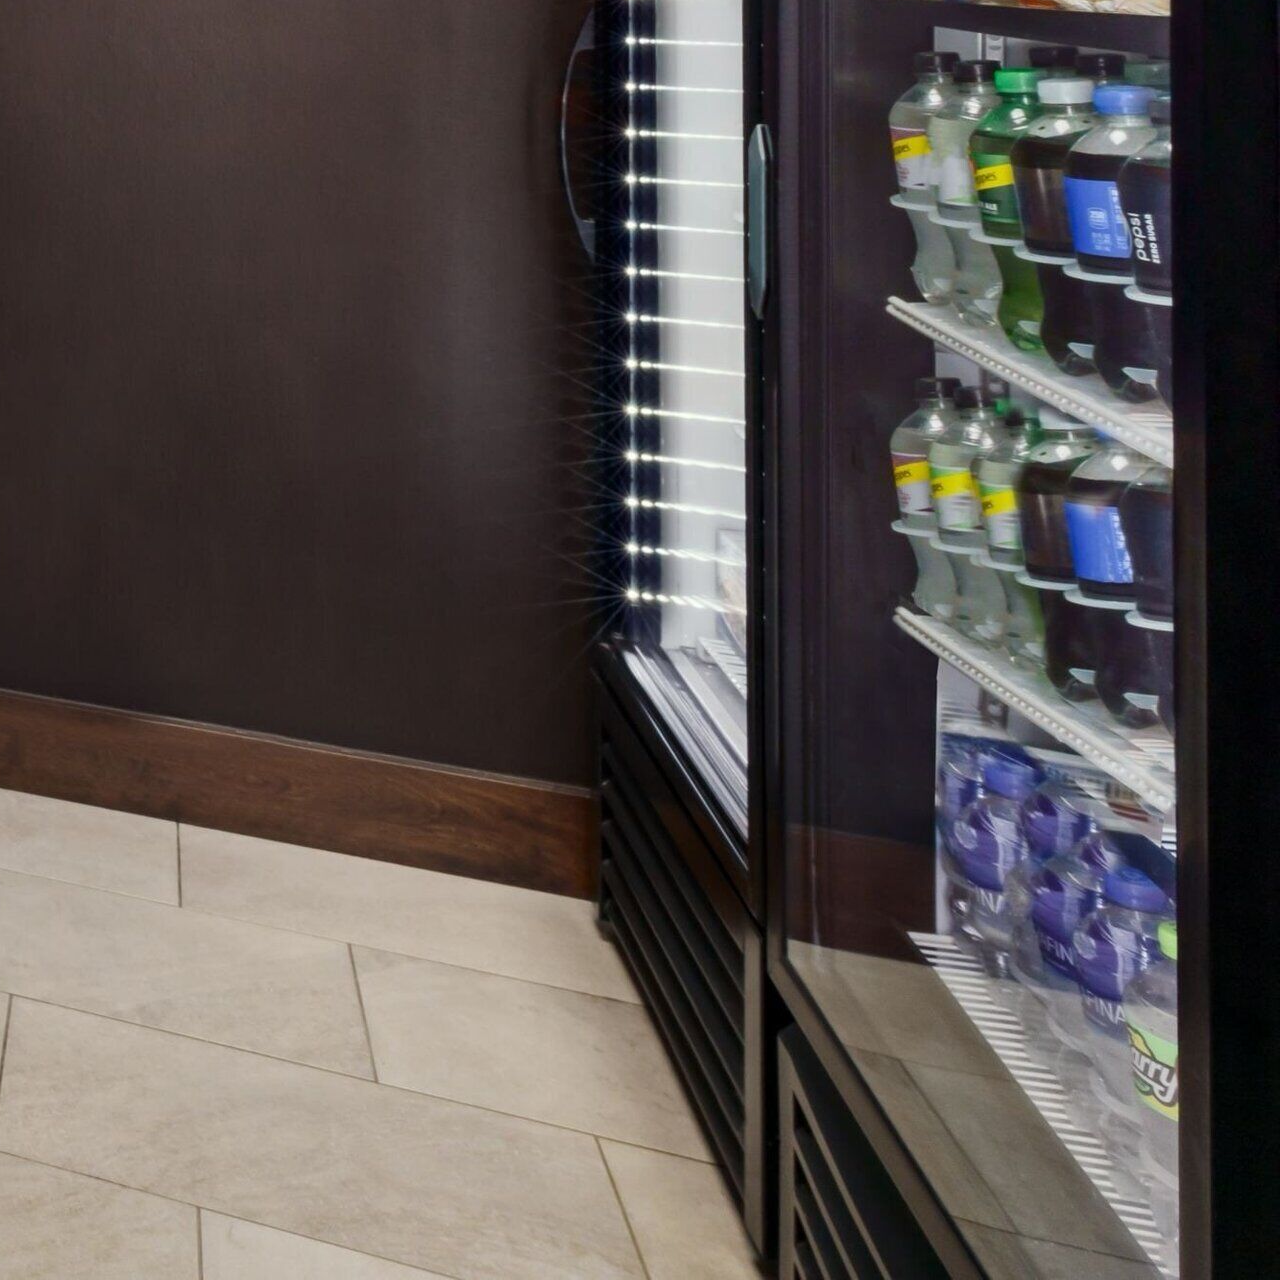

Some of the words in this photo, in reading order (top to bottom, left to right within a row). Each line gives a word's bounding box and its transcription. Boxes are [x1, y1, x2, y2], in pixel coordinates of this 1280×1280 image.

[1131, 211, 1150, 262] pepsi
[1143, 213, 1159, 240] SUGAR
[1145, 238, 1161, 265] ZERO
